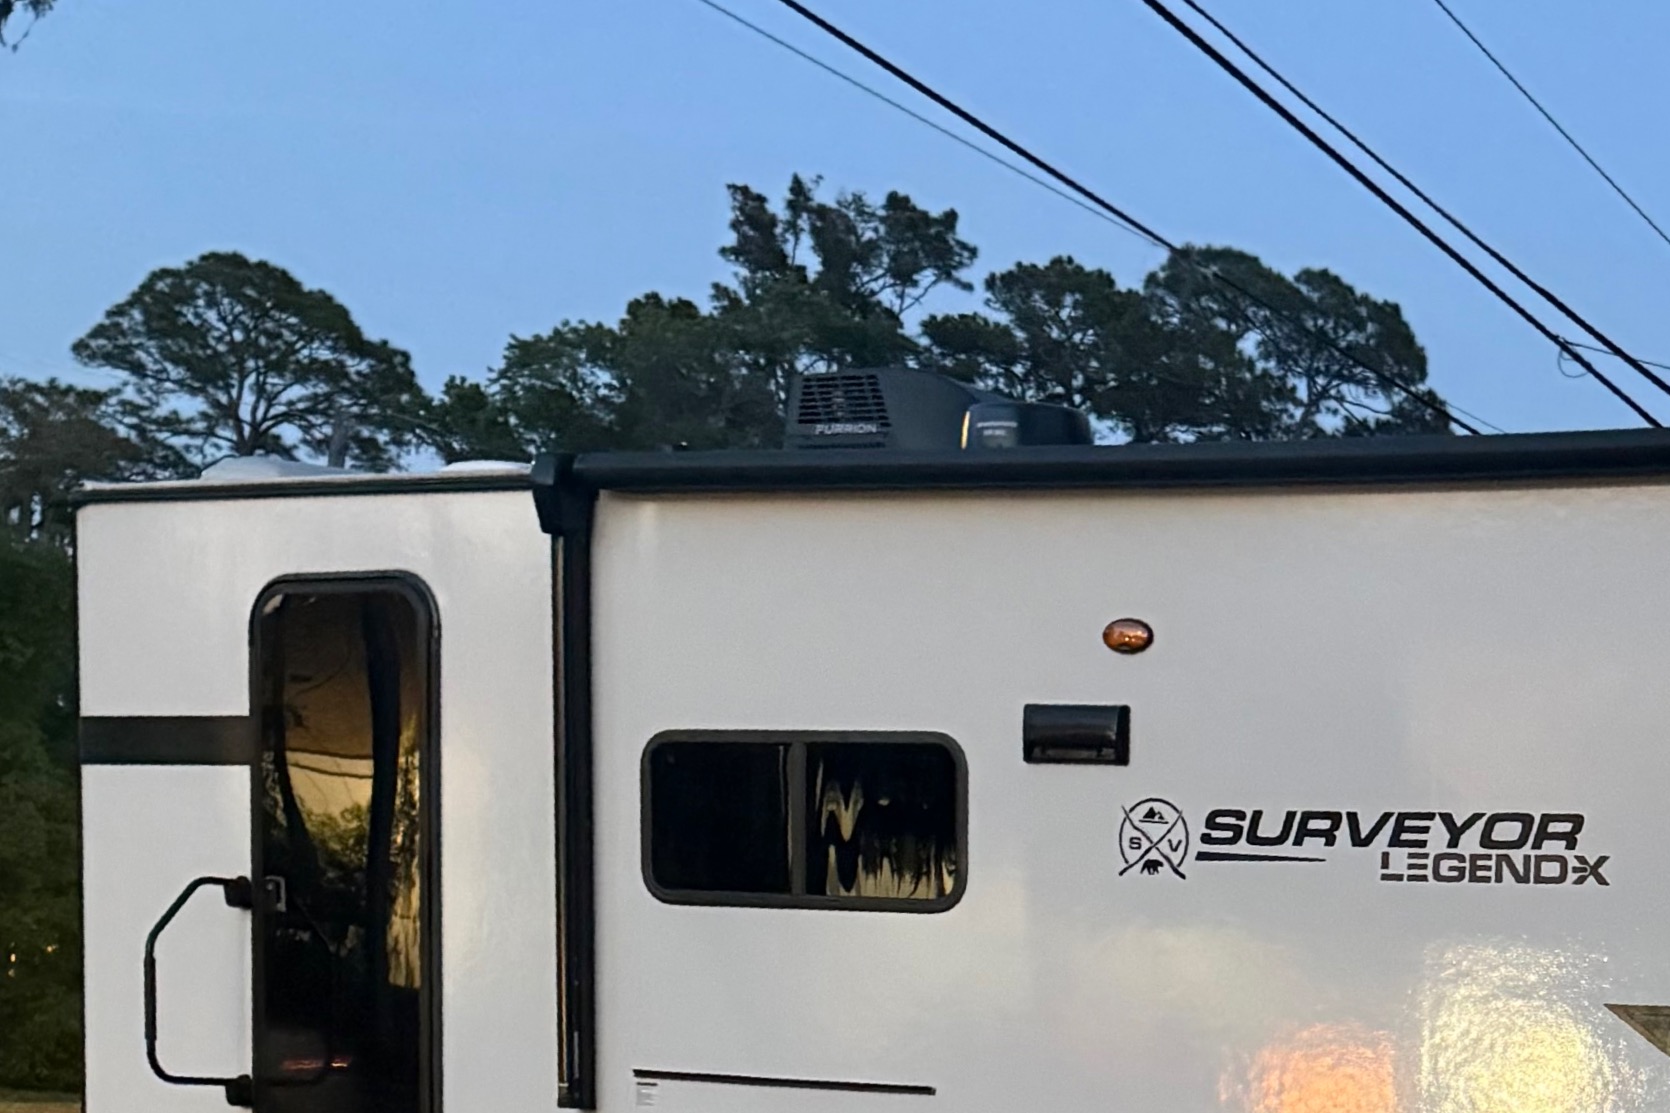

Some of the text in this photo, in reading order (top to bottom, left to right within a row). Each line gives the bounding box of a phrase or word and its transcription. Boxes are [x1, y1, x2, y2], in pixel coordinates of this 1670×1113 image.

[814, 423, 878, 435] FURRION
[1199, 809, 1585, 850] SURVEYOR
[1129, 836, 1182, 852] S V
